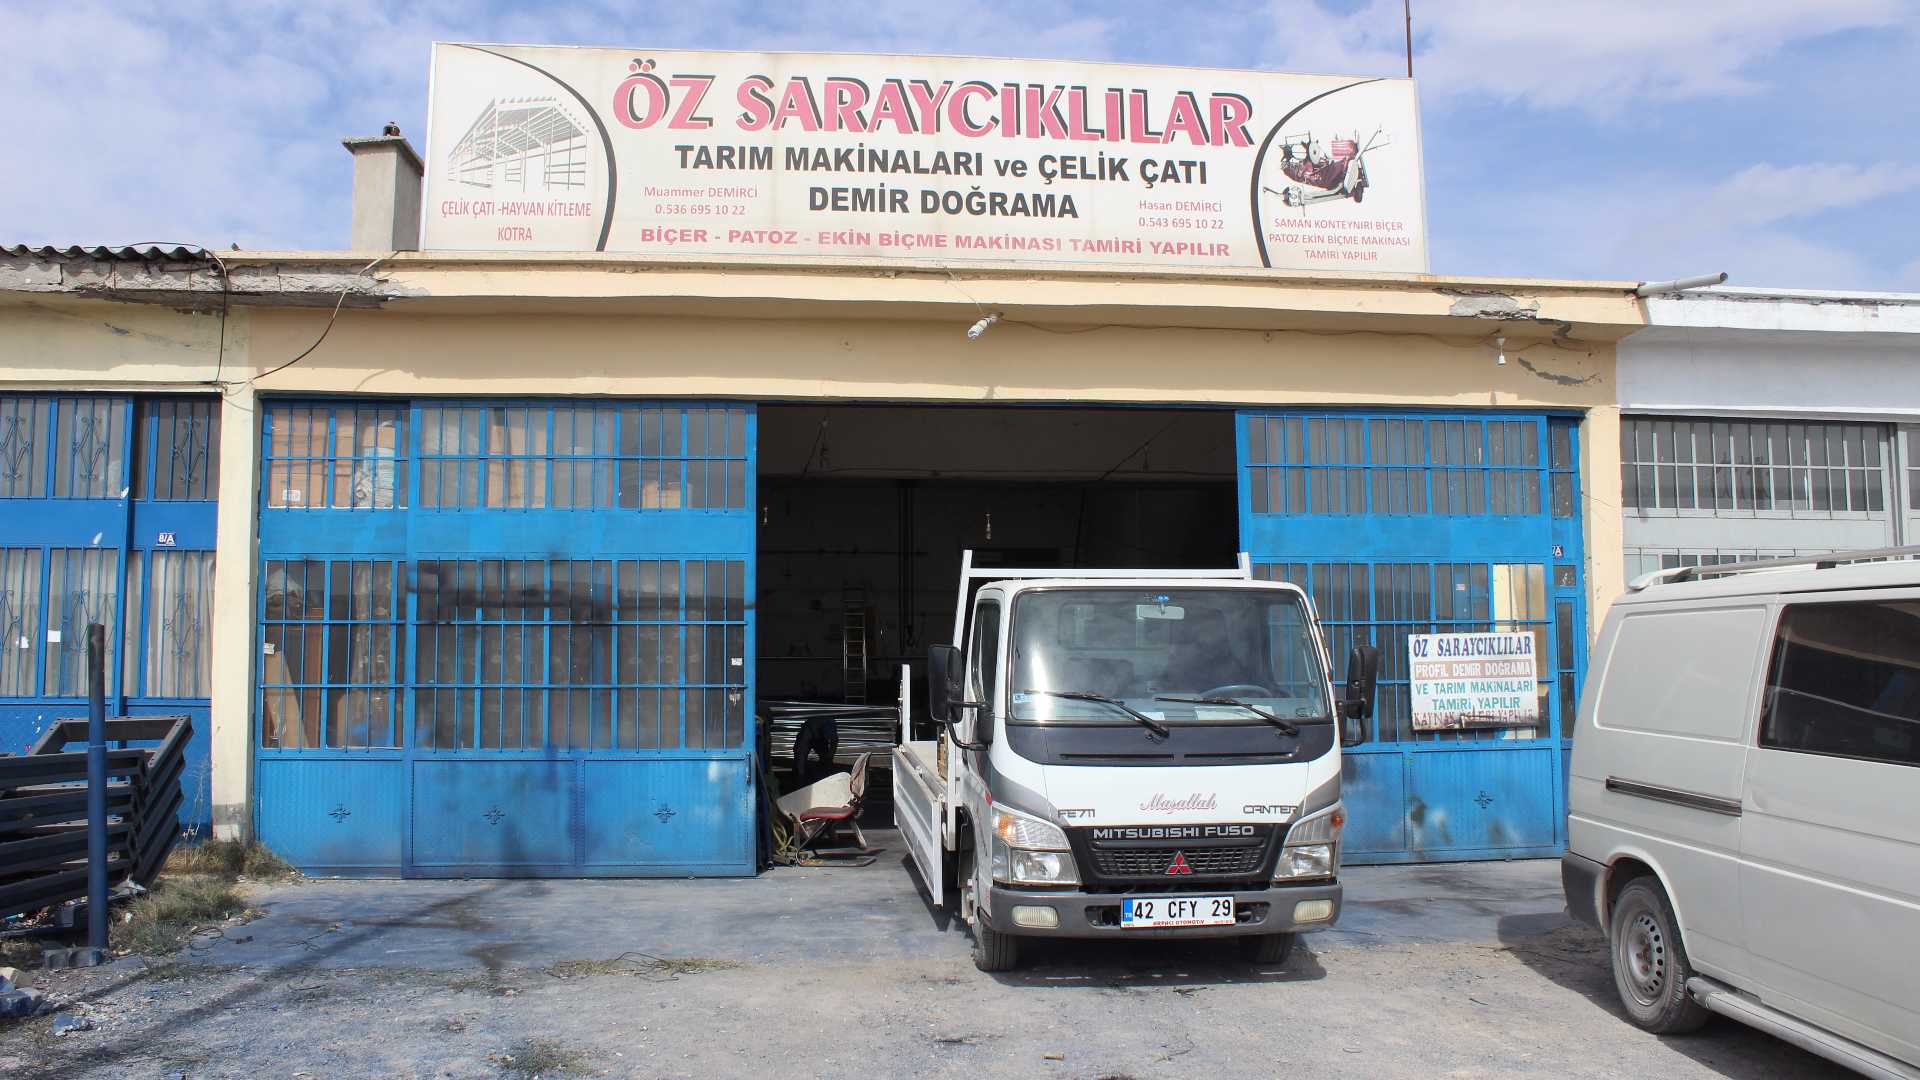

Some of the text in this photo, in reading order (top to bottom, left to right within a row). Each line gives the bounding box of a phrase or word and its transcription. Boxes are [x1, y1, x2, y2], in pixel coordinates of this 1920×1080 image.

[613, 58, 1255, 148] ÖZ SARAYCIKLILAR
[675, 142, 1207, 188] TARIM MAKİNALARI ve ÇELİK ÇATI
[643, 184, 758, 199] Muammer DEMİRCİ
[809, 182, 1079, 219] DEMİR DOĞRAMA
[1139, 199, 1222, 213] Hasan DEMİRCİ
[441, 197, 470, 218] ÇELİK
[472, 200, 495, 220] ÇATI
[547, 198, 592, 218] KİTLEME
[654, 204, 746, 216] 0.536 695 10 22
[1138, 217, 1224, 230] 0.543 695 10 22
[1274, 218, 1311, 229] SAMAN
[497, 226, 533, 241] KOTRA
[1269, 234, 1299, 244] PATOZ
[641, 226, 708, 246] BİÇER
[728, 229, 798, 245] PATOZ
[818, 229, 871, 246] EKİN
[878, 230, 947, 250] BİÇME
[955, 233, 1062, 252] MAKİNASI
[1069, 238, 1142, 254] TAMİRİ
[1149, 242, 1230, 257] YAPILIR
[1342, 250, 1378, 262] YAPILIR
[1437, 635, 1532, 657] SARAYCIKLILAR
[1485, 661, 1531, 676] DOĞRAMA
[1415, 683, 1429, 695] VE
[1434, 682, 1466, 695] TARIM
[1478, 697, 1521, 709] YAPILIR
[1242, 804, 1298, 815] CANTER
[1093, 824, 1255, 840] MITSUBISHI FUSO
[1134, 899, 1232, 919] 42 CFY 29
